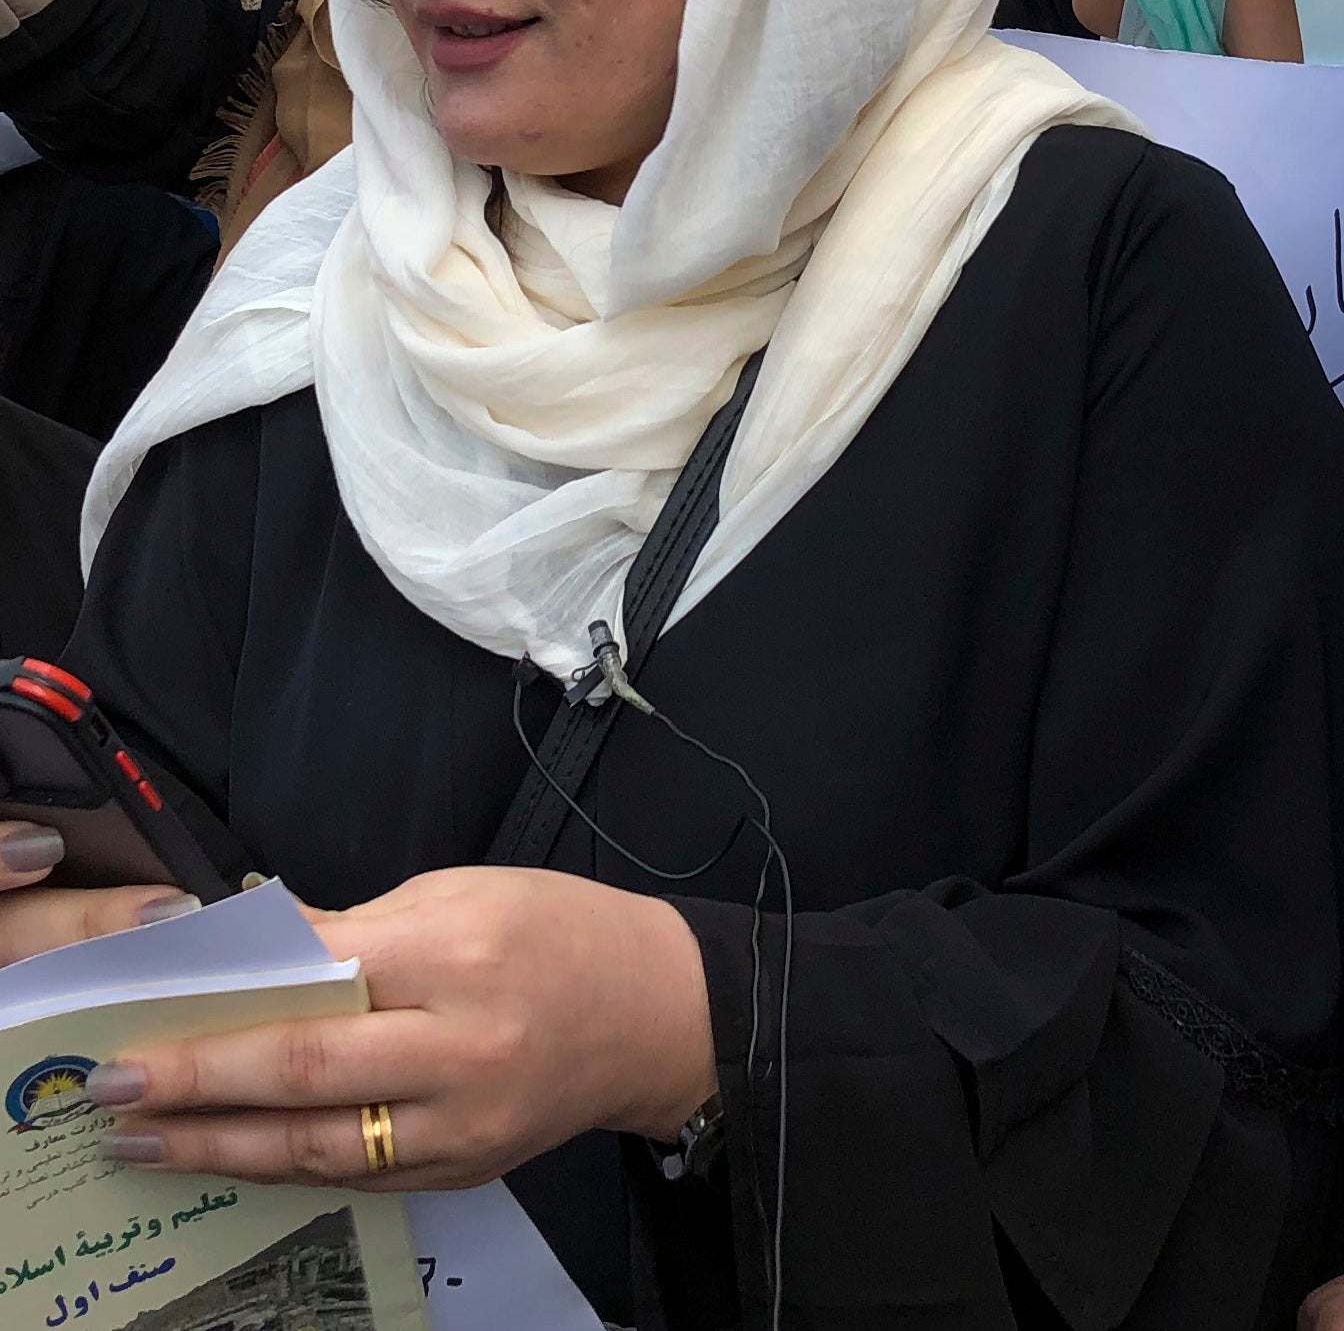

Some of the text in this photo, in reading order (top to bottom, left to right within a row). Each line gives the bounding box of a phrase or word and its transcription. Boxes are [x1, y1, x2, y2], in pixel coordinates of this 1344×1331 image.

[171, 1185, 238, 1230] تعلیم
[45, 1256, 176, 1328] صنف اول
